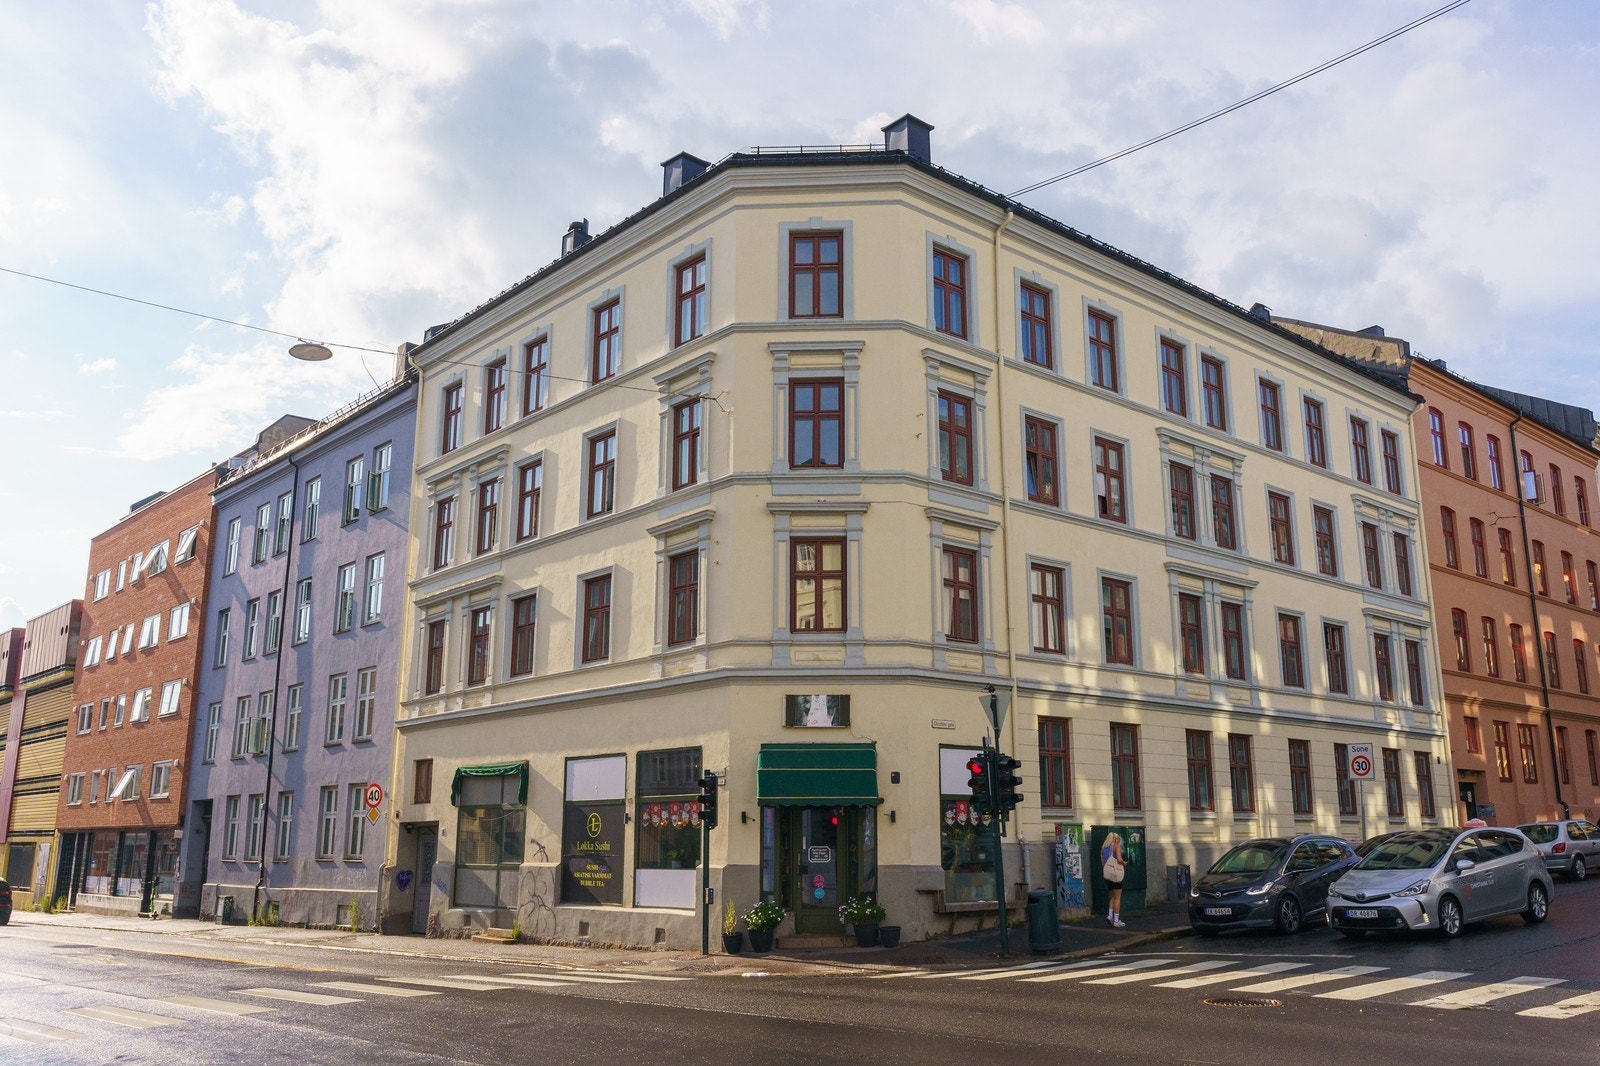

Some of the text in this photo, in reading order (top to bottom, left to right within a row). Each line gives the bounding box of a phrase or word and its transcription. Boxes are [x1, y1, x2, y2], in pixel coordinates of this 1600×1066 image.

[1351, 745, 1369, 753] Sone
[1355, 761, 1368, 771] 30
[368, 789, 380, 801] 40
[595, 841, 611, 850] Sushi
